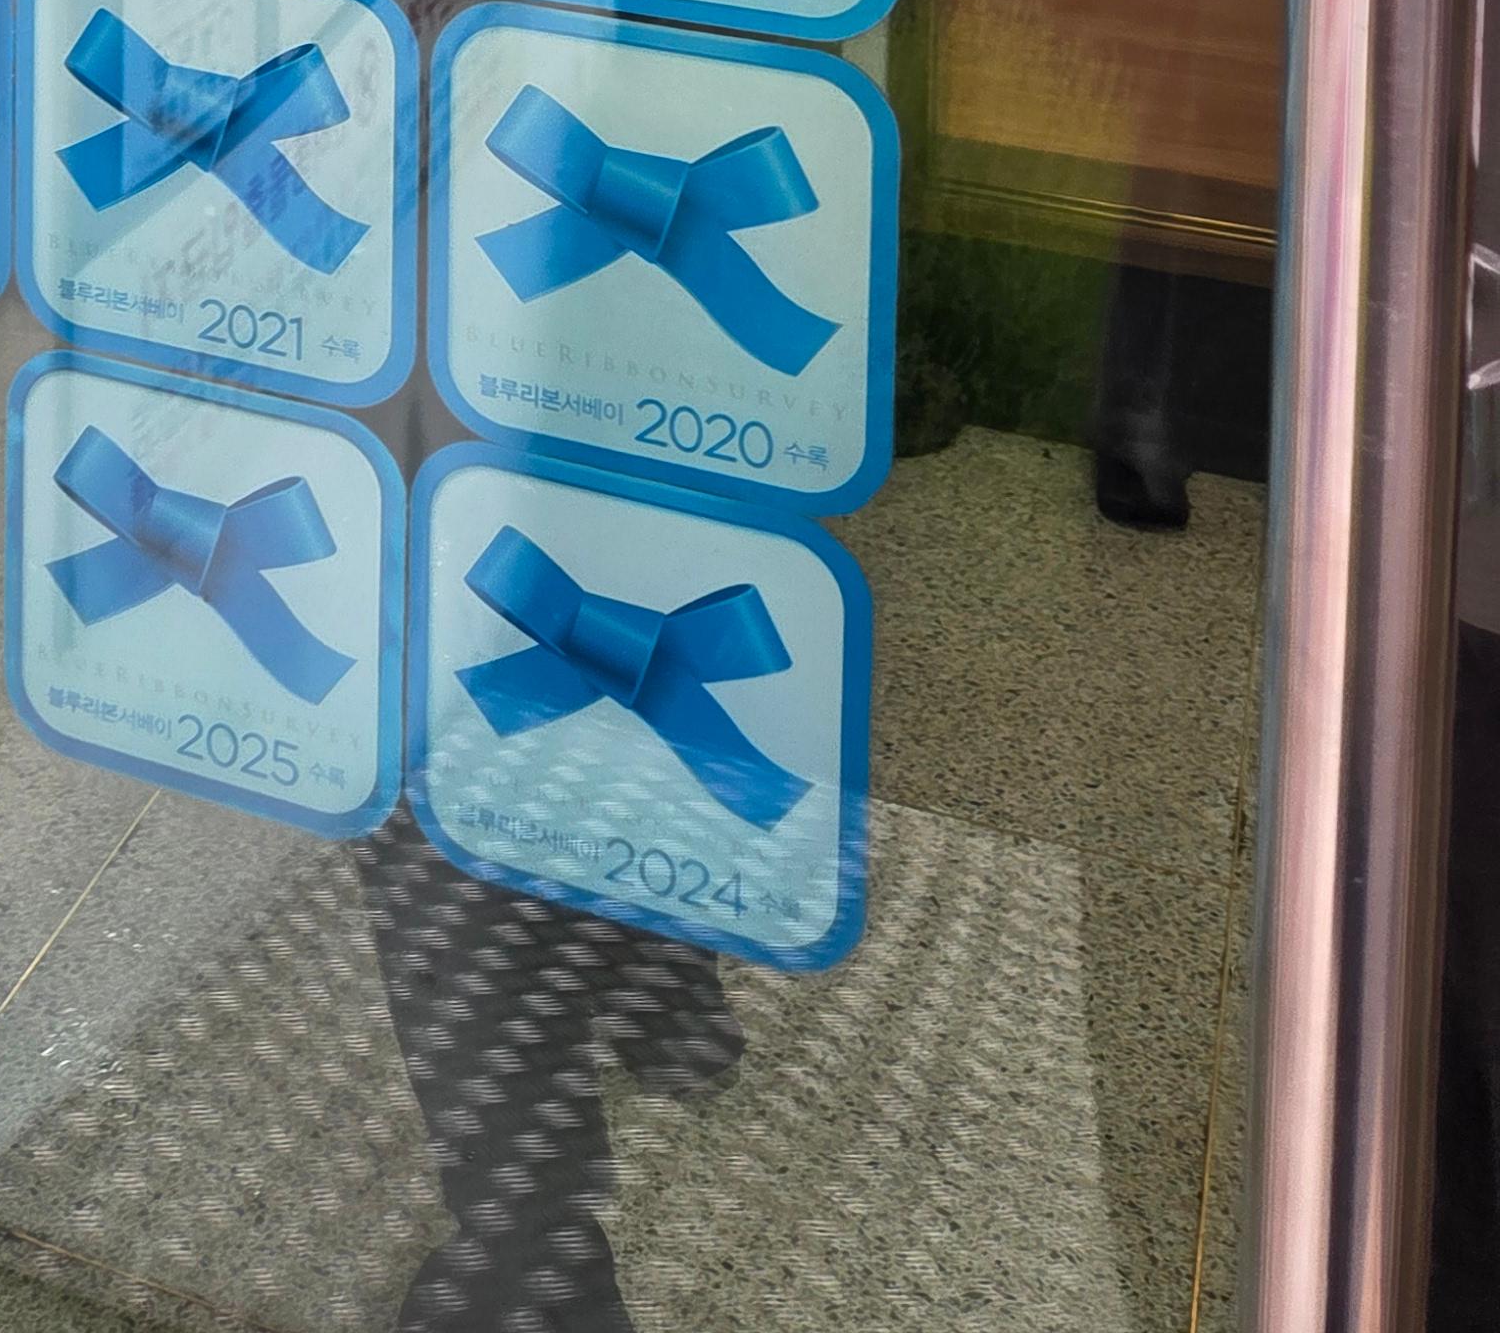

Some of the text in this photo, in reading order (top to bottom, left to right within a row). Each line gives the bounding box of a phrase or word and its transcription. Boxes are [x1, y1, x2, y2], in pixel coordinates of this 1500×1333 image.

[57, 277, 364, 362] 블루리본서베이 2021 수록
[478, 372, 831, 471] 블루리본서베이 2020 수록
[176, 713, 301, 788] 2025
[603, 837, 748, 919] 2024
